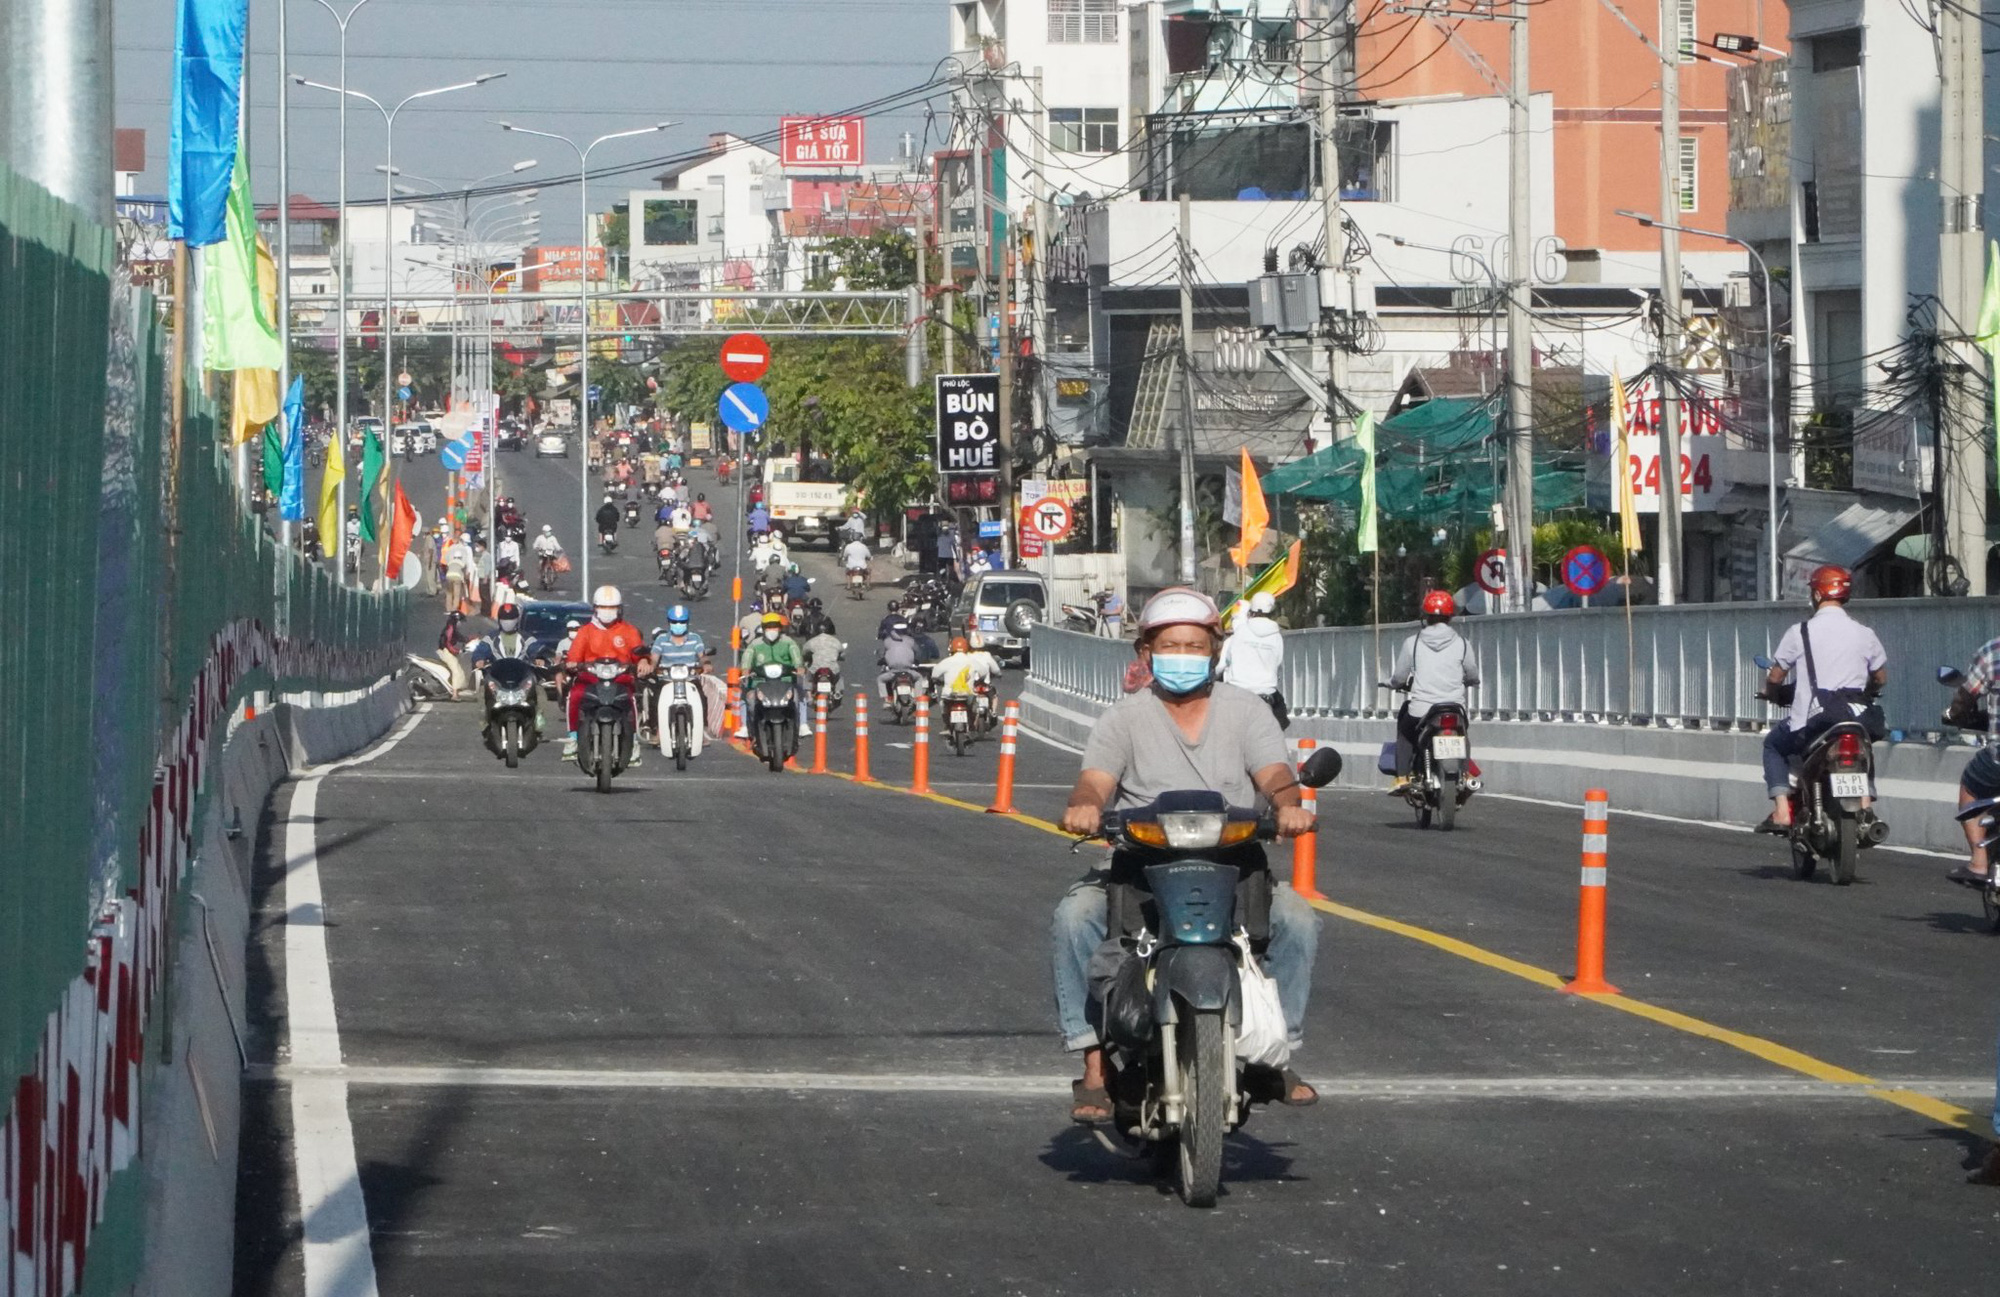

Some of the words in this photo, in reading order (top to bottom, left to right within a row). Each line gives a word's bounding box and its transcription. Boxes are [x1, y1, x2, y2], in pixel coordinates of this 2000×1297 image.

[796, 142, 818, 160] GIÁ
[824, 141, 849, 160] TỐT
[125, 203, 155, 219] PNJ
[946, 388, 995, 413] BÚN
[954, 415, 989, 441] BÒ
[948, 438, 998, 467] HUẾ
[1837, 785, 1865, 795] 0385
[1169, 865, 1215, 874] HONDA
